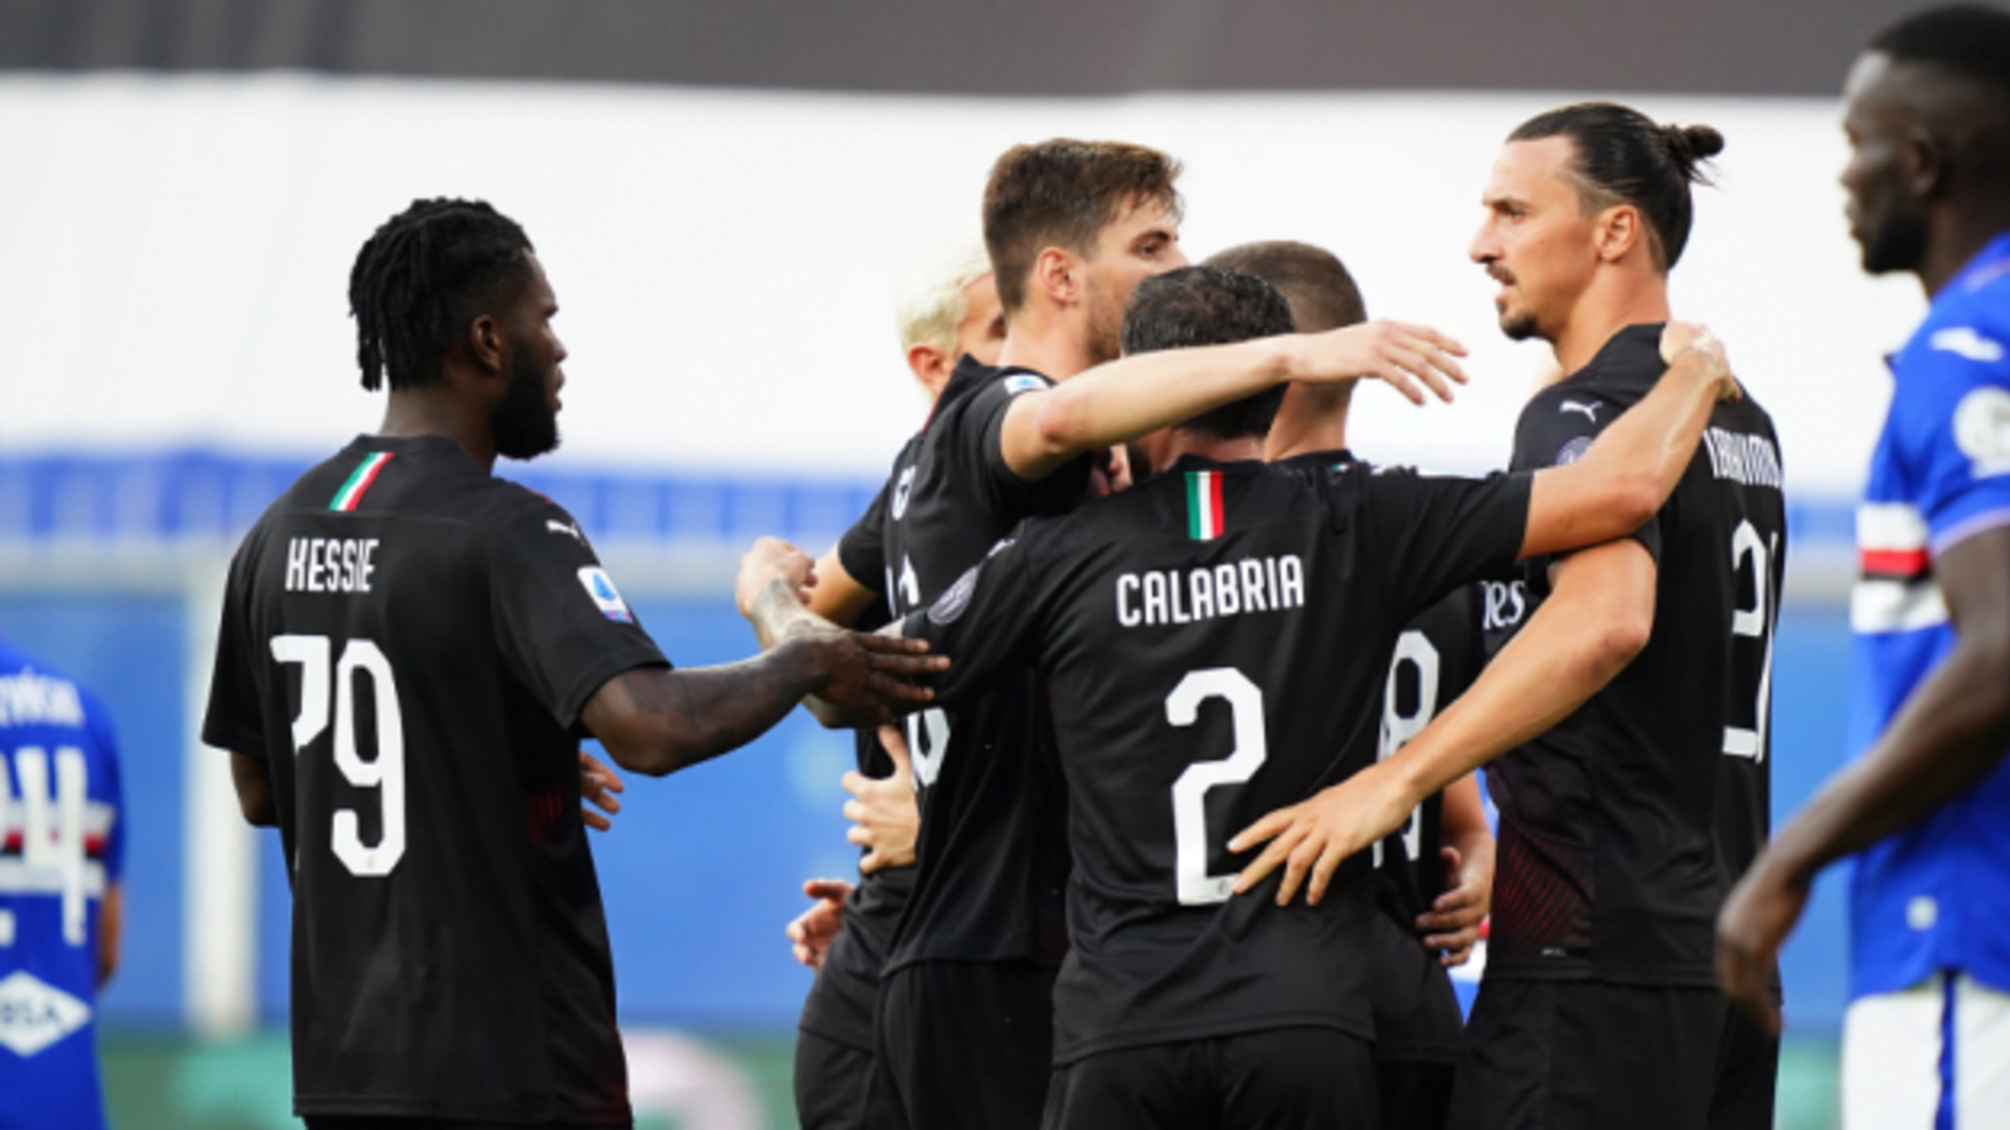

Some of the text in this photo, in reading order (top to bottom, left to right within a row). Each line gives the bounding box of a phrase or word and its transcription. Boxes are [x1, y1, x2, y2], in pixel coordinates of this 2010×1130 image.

[286, 538, 379, 592] KESSIE
[1116, 554, 1304, 626] CALABRIA
[270, 634, 406, 877] 79
[1165, 667, 1267, 906] 2
